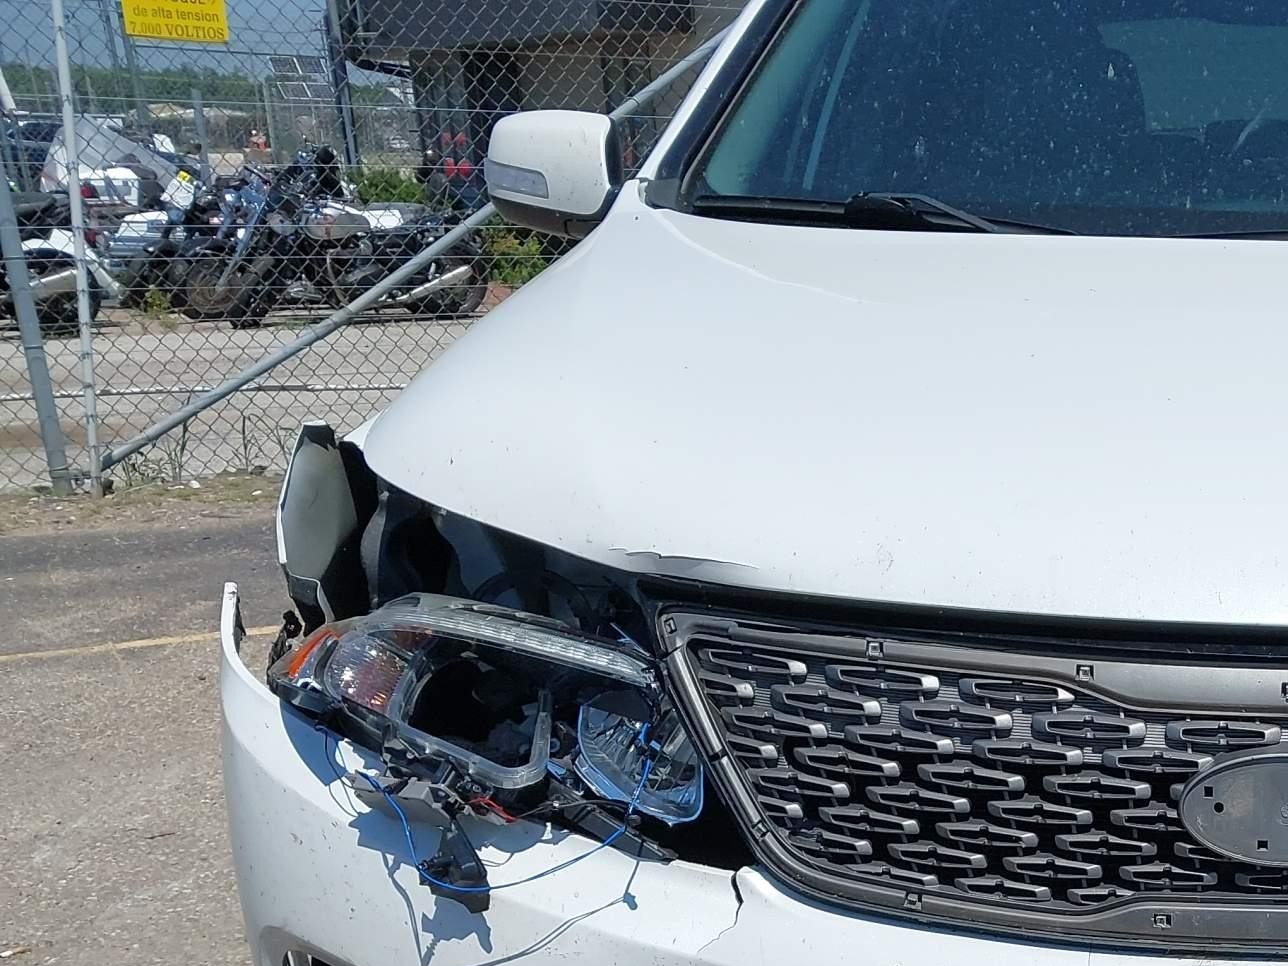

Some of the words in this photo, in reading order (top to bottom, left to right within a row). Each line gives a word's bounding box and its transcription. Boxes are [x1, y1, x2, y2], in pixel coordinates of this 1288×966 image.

[132, 5, 148, 17] de
[151, 6, 173, 20] alta
[176, 9, 220, 22] tension
[164, 23, 225, 40] VOLTIOS
